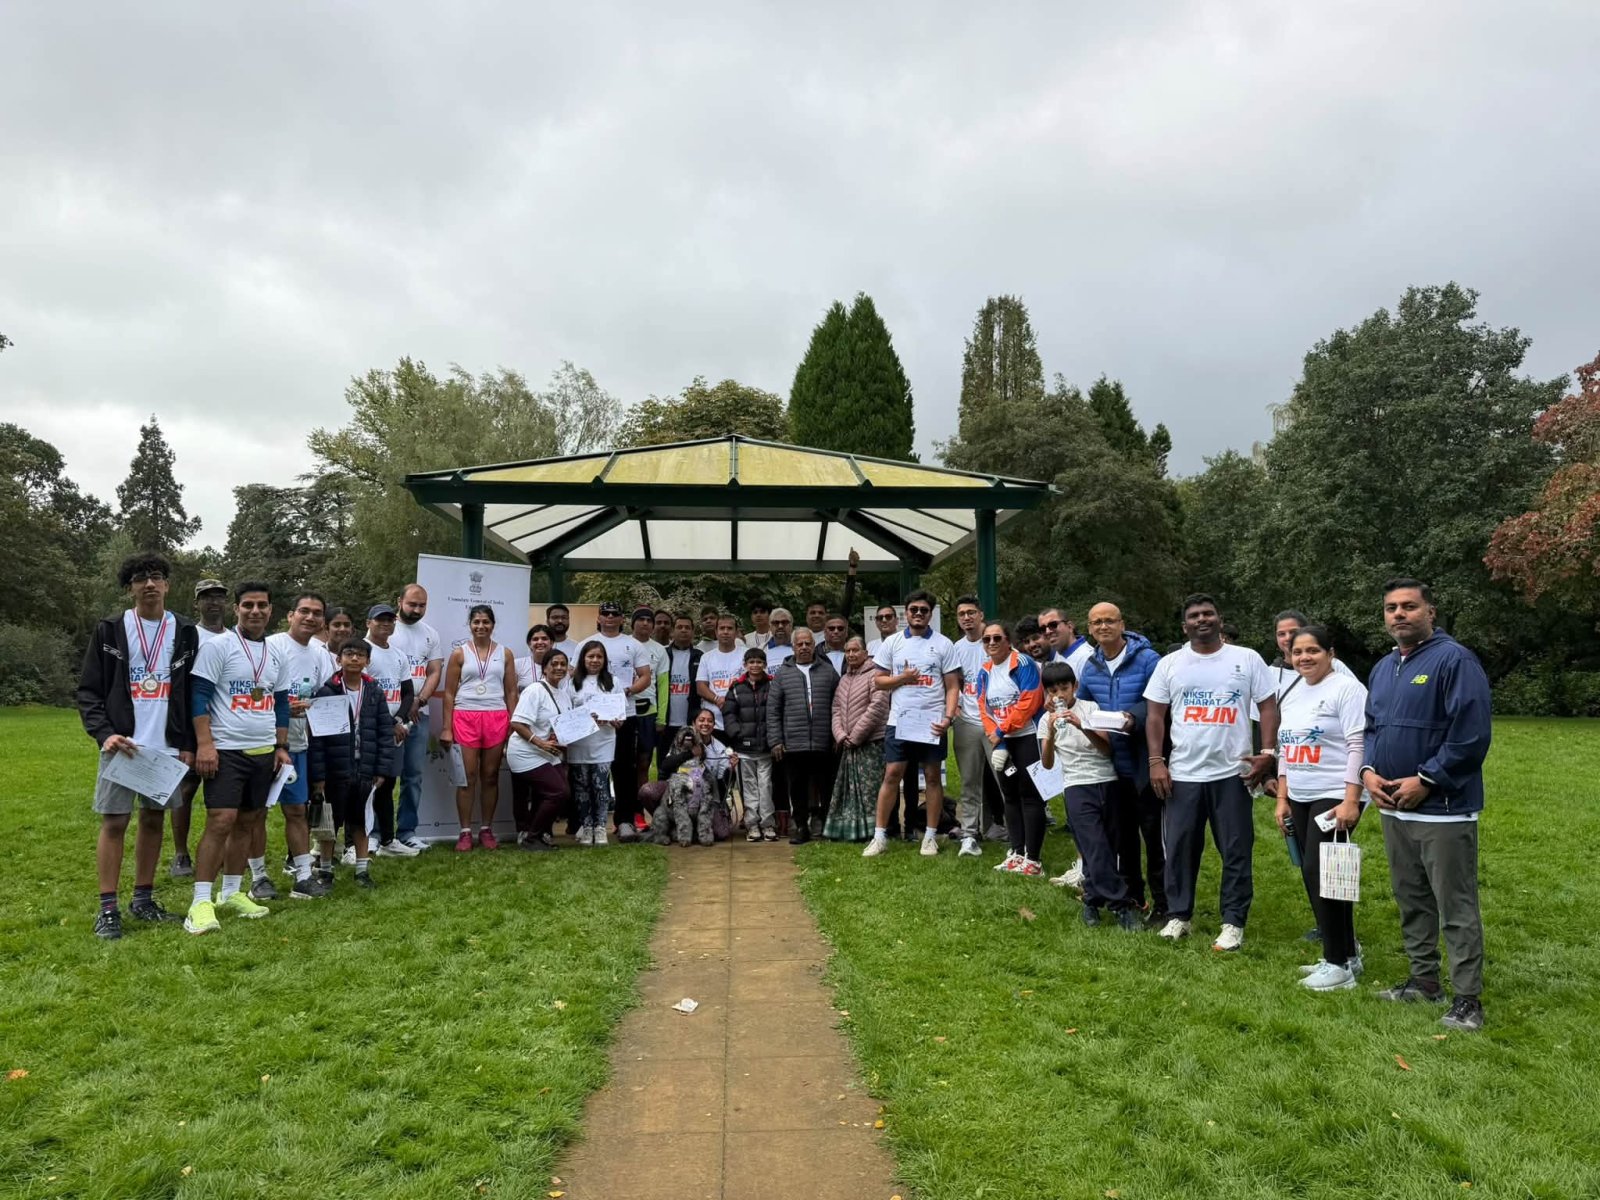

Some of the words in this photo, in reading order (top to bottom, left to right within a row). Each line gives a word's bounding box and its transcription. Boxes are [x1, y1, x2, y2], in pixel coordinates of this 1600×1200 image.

[1183, 691, 1213, 699] VIKSIT
[1183, 698, 1221, 706] BHARAT
[1183, 706, 1238, 724] RUN
[1285, 744, 1322, 764] UN
